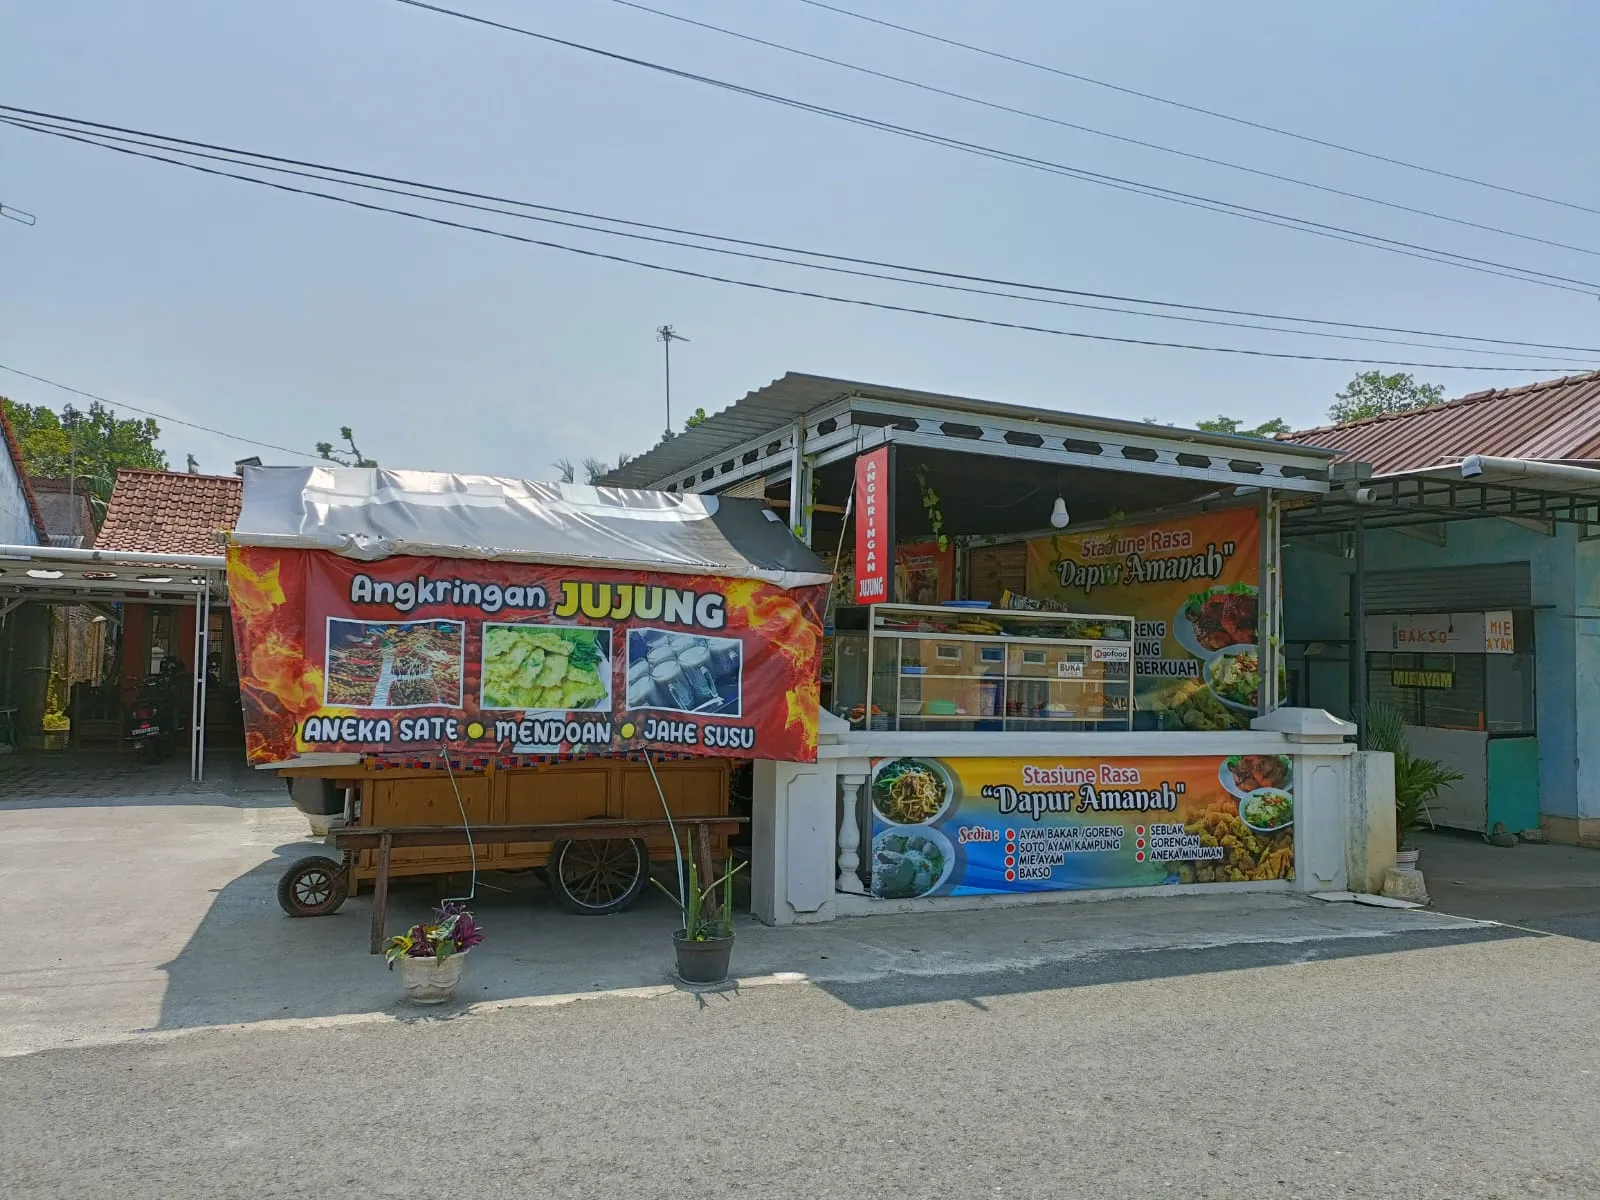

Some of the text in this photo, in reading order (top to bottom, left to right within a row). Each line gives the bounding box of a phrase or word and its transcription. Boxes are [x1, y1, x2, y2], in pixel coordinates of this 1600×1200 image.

[866, 460, 876, 573] ANGKRINGAN
[1151, 531, 1192, 550] Rasa
[859, 577, 884, 597] JUJUNG
[351, 574, 724, 629] Angkringan JUJUNG
[1490, 621, 1511, 635] MIE
[1399, 629, 1448, 643] BAKSO
[1487, 638, 1513, 650] AYAM
[1102, 650, 1127, 659] gofood
[1060, 664, 1081, 672] BUKA
[1136, 661, 1197, 676] BERKUAH
[1394, 671, 1452, 688] MIE AYAM
[304, 717, 458, 741] ANEKA SATE
[496, 719, 611, 743] MENDOAN
[644, 719, 754, 748] JAHE SUSU
[1024, 767, 1139, 783] Stasiune Rasa
[1020, 829, 1045, 840] AYAM
[1047, 828, 1078, 839] BAKAR
[1150, 825, 1183, 836] SEBLAK
[1020, 839, 1120, 853] SOTO AYAM KAMPUNG
[1151, 837, 1199, 848] GORENGAN
[1020, 853, 1063, 865] MIE AYAM
[1150, 848, 1223, 860] ANEKA MINUMAN
[1020, 867, 1051, 878] BAKSO
